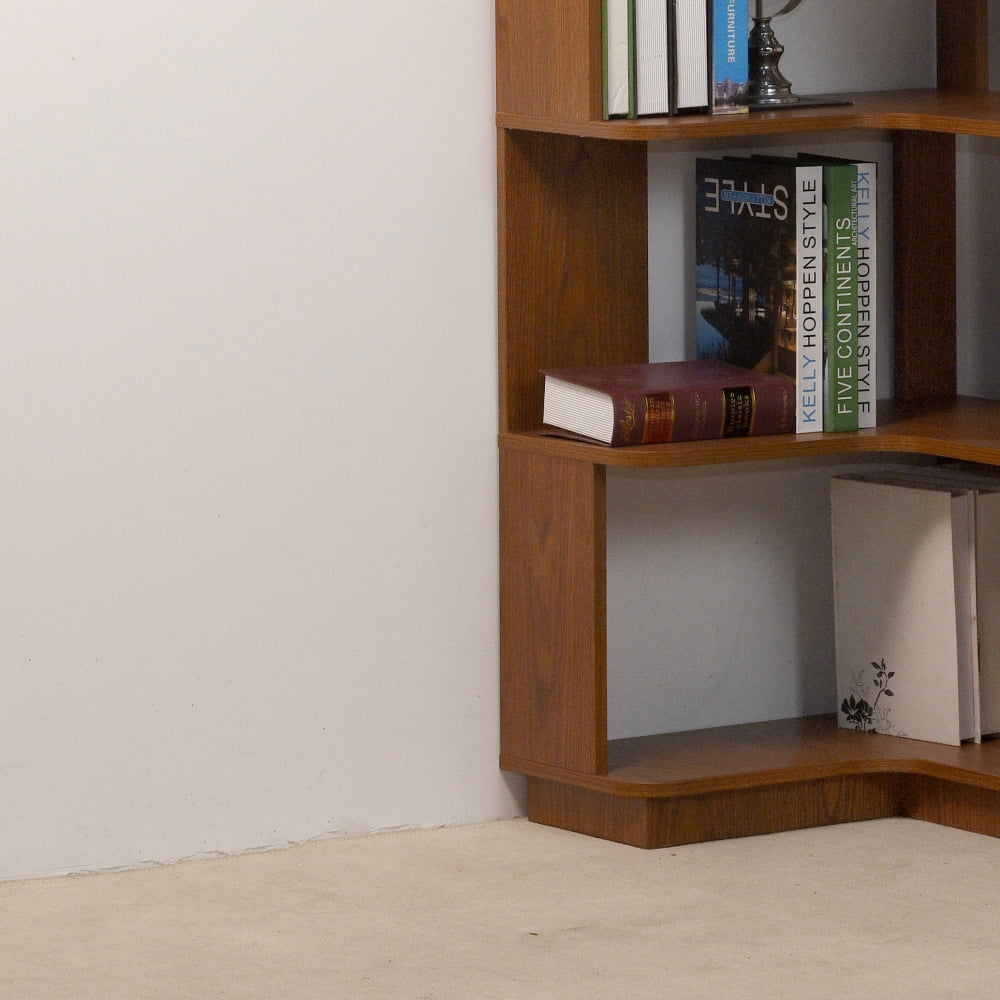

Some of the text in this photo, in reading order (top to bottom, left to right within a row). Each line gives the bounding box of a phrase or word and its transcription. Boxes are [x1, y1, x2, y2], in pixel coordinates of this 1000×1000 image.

[704, 177, 789, 221] STYLE
[803, 178, 817, 422] KELLY HOPPEN STYLE
[836, 217, 852, 415] FIVE CONTINENTS
[857, 247, 870, 338] HOPPEN
